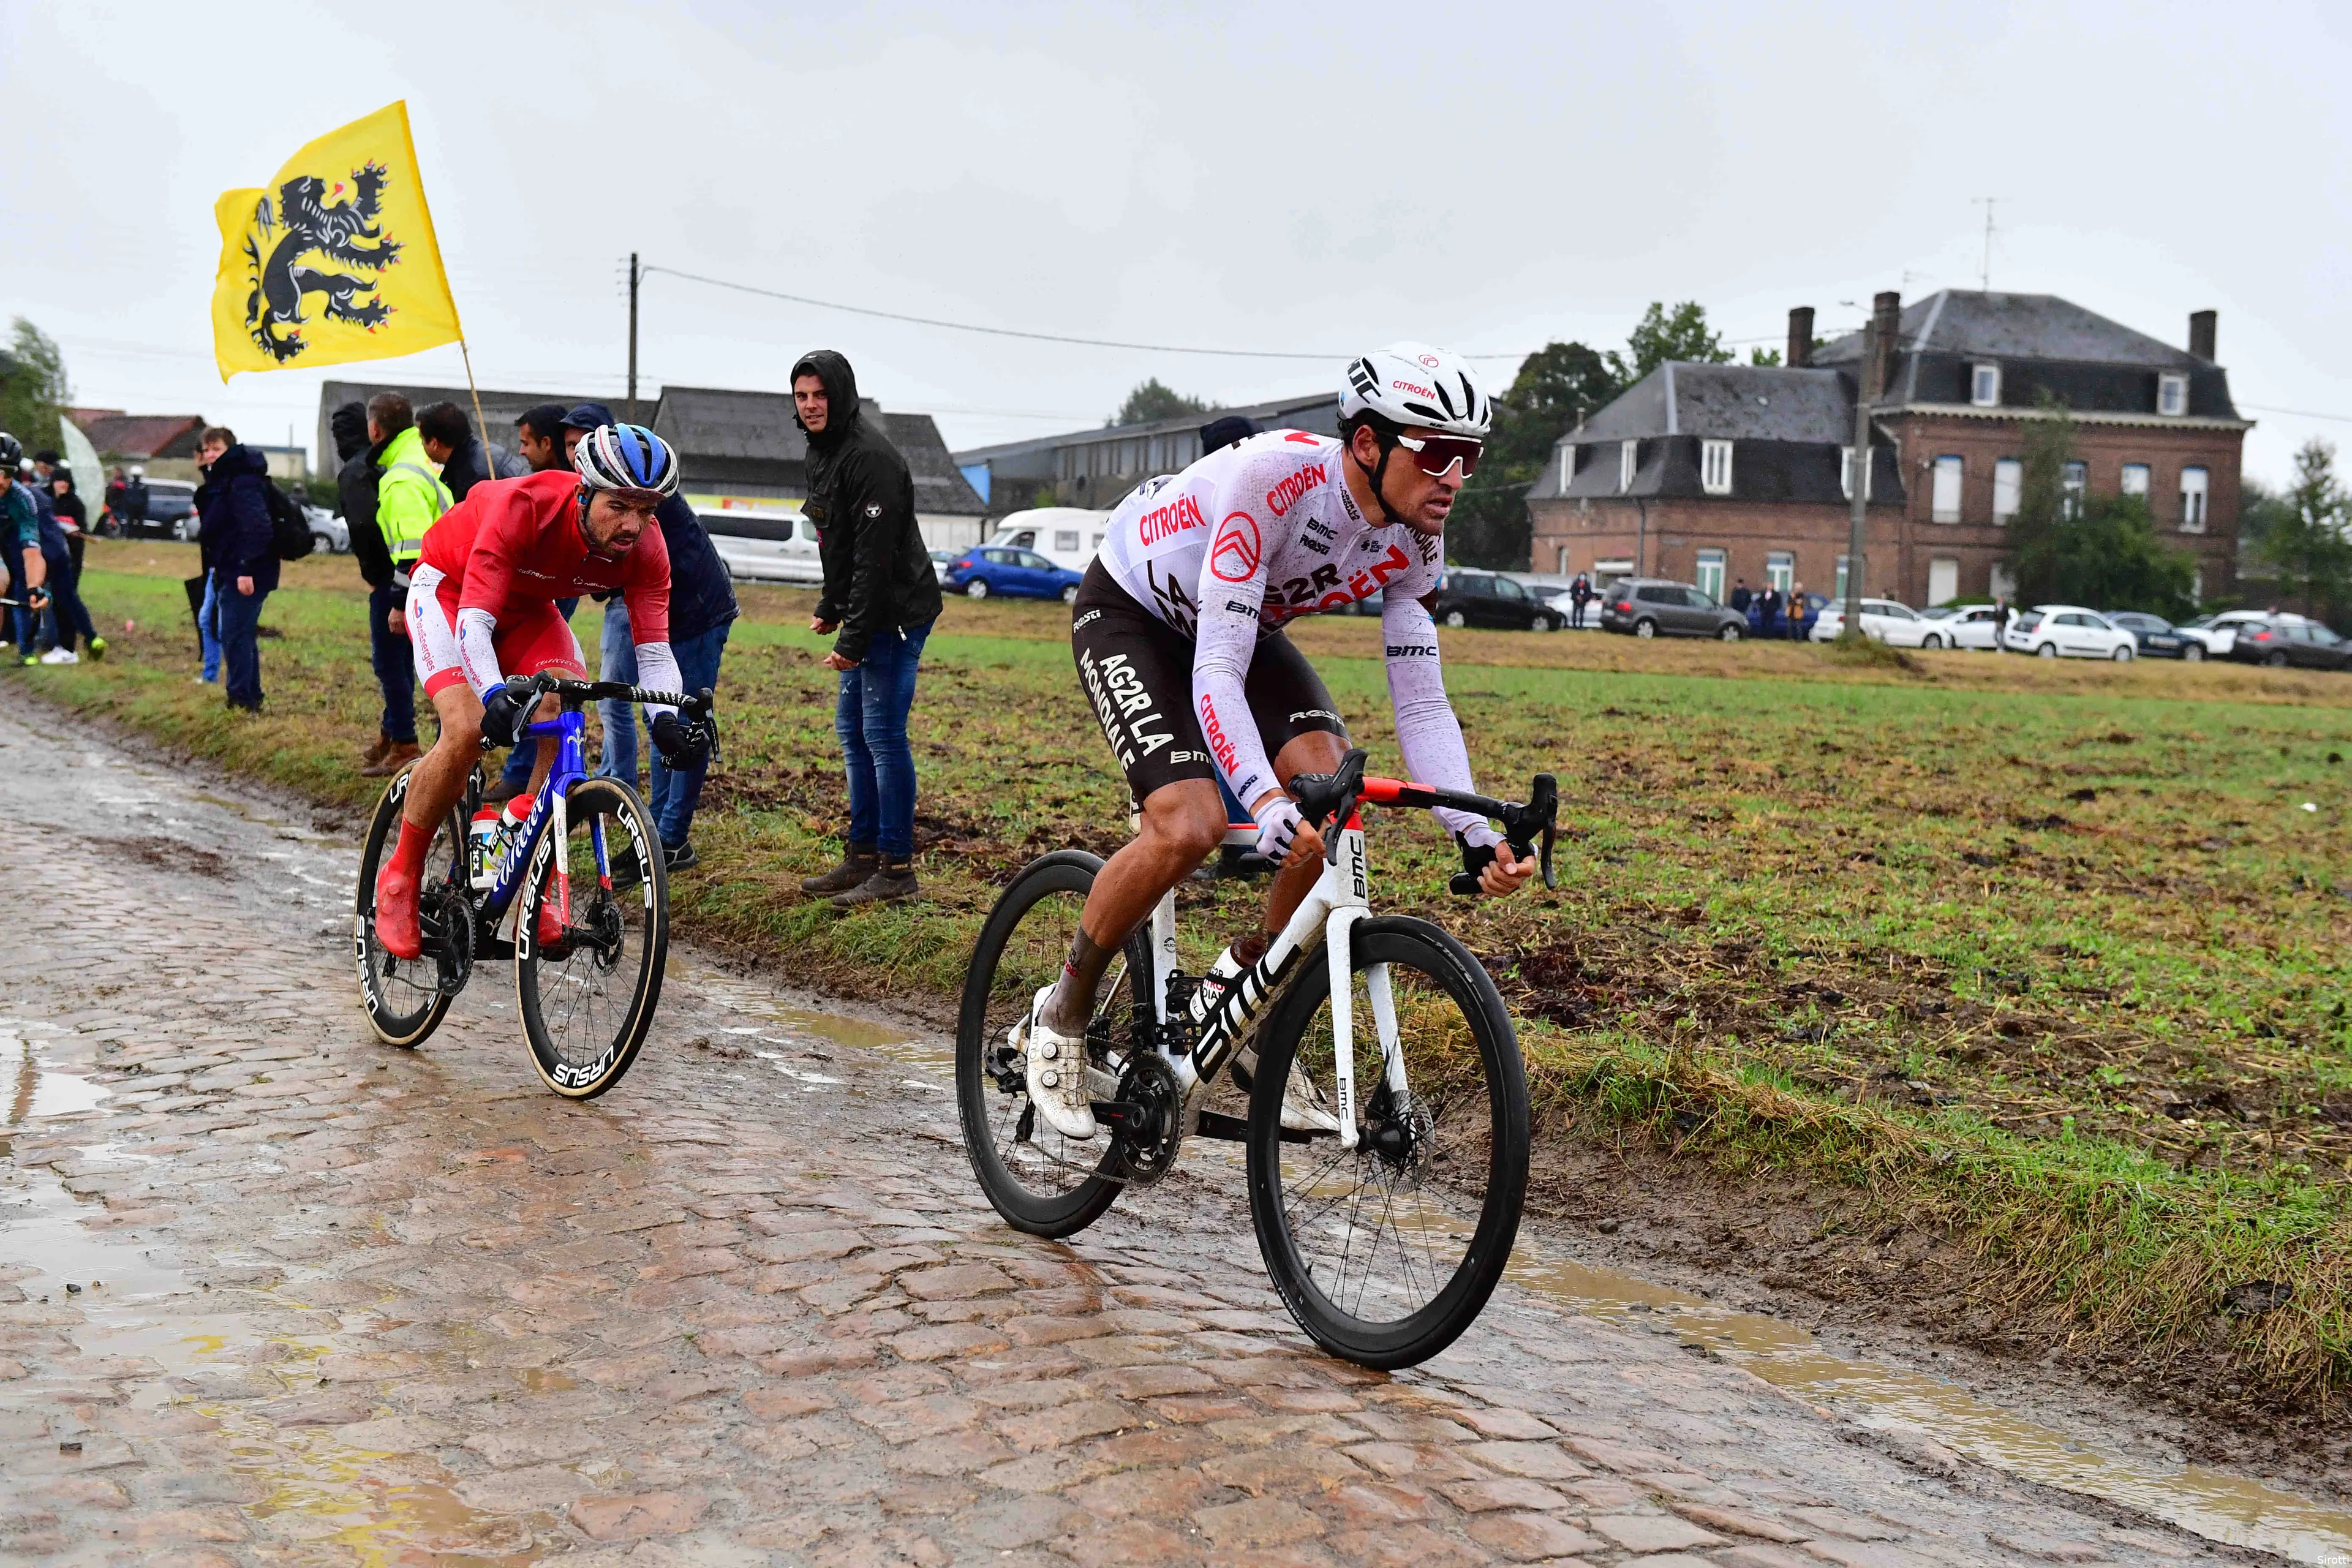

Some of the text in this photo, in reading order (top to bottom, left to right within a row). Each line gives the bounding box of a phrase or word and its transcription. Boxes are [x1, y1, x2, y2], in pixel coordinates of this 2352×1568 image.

[1392, 380, 1436, 401] CITROËN
[1266, 462, 1327, 517] CITROËN
[1139, 492, 1207, 546] CITROËN
[1306, 516, 1338, 540] BMC
[1226, 600, 1260, 622] BM
[1262, 564, 1343, 606] G2R
[416, 618, 435, 672] TotalEnergies
[460, 641, 483, 687] TotalEnergies
[1387, 646, 1437, 657] BMC
[1080, 647, 1136, 771] MONDIALE
[1099, 654, 1175, 757] AG2R LA
[1170, 750, 1213, 764] BM
[1200, 693, 1240, 778] CITROËN
[617, 802, 652, 909] URSUS
[1349, 836, 1366, 899] BMC
[519, 834, 551, 960] URSUS
[356, 913, 379, 1016] URSUS
[1192, 943, 1303, 1085] BMC
[552, 1044, 614, 1087] URSUS
[1339, 1077, 1348, 1120] BMC
